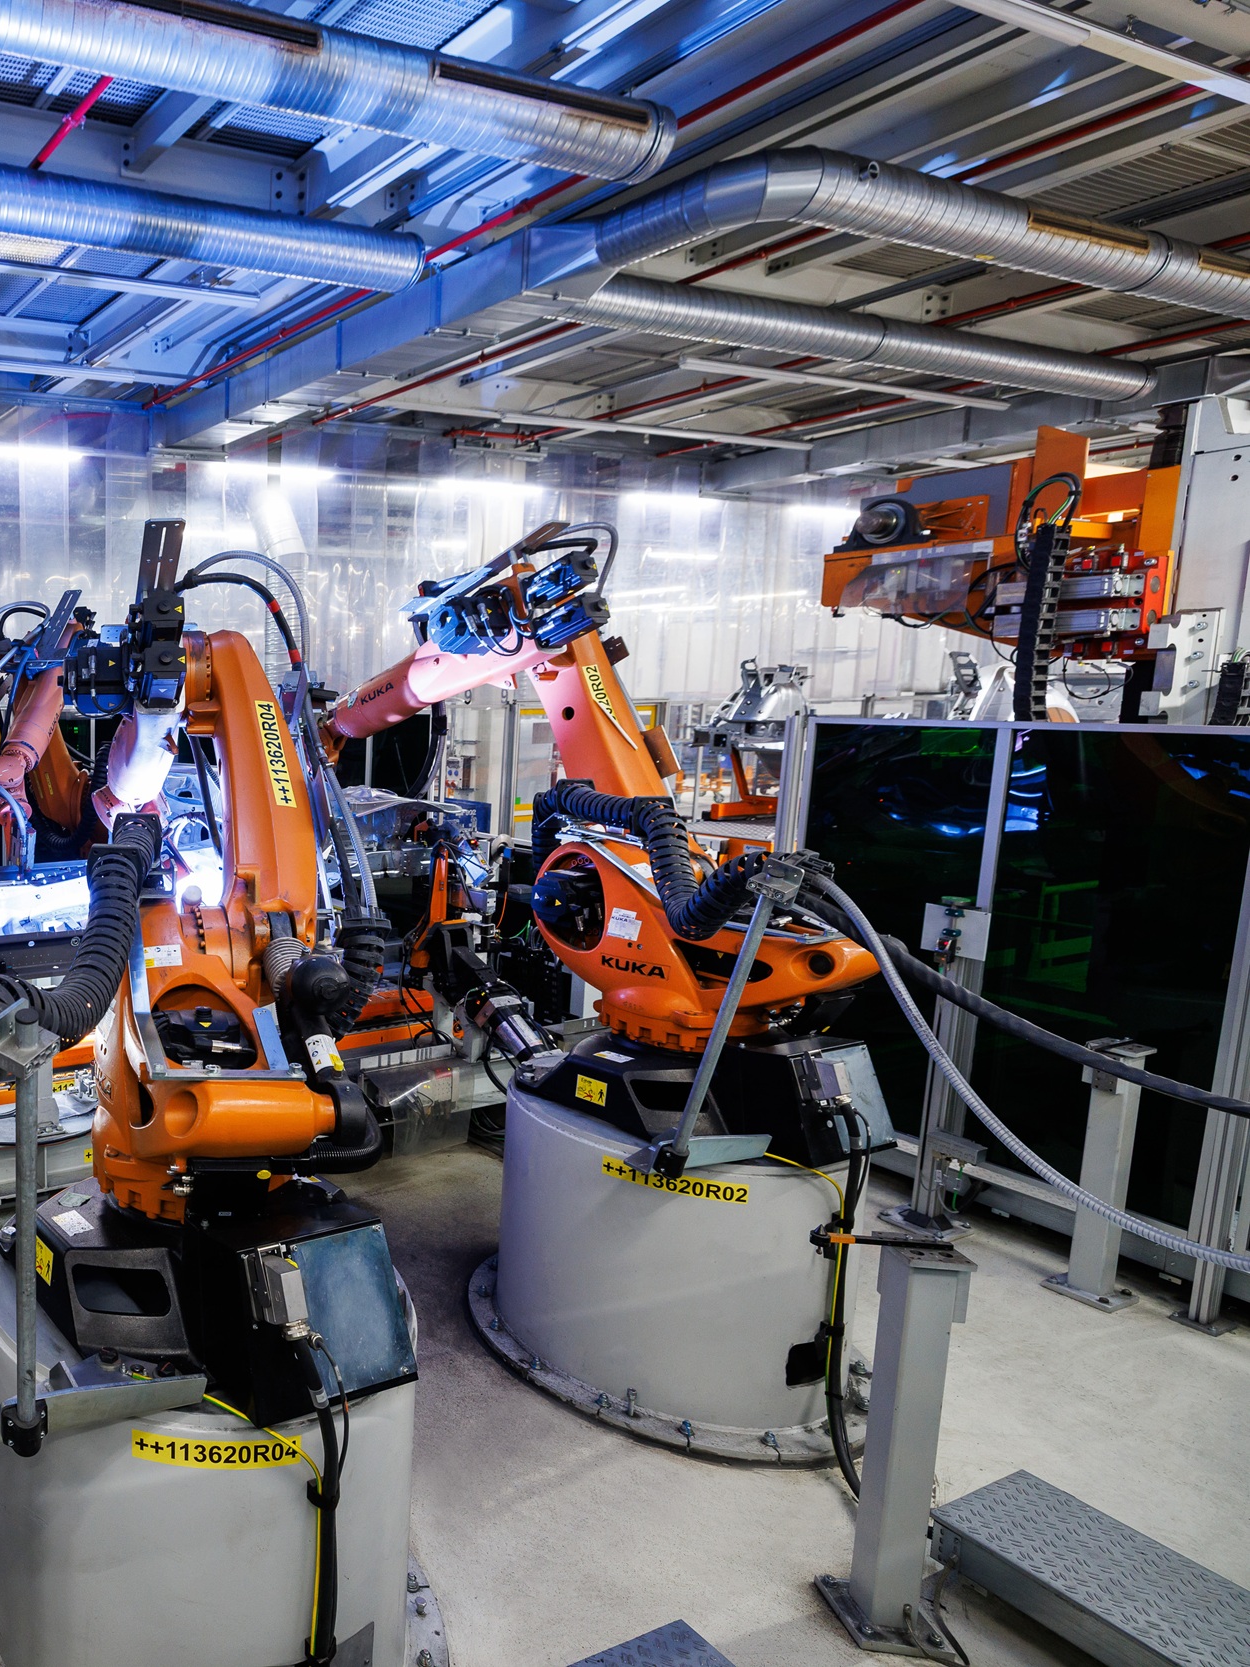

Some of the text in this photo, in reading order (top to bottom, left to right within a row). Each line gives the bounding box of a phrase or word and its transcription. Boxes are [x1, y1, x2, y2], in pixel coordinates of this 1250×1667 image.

[360, 682, 394, 705] KUKA
[258, 703, 292, 804] ++113620R04
[602, 955, 666, 979] KUKA
[603, 1162, 748, 1203] ++113620R02
[135, 1438, 299, 1464] ++113620R04
